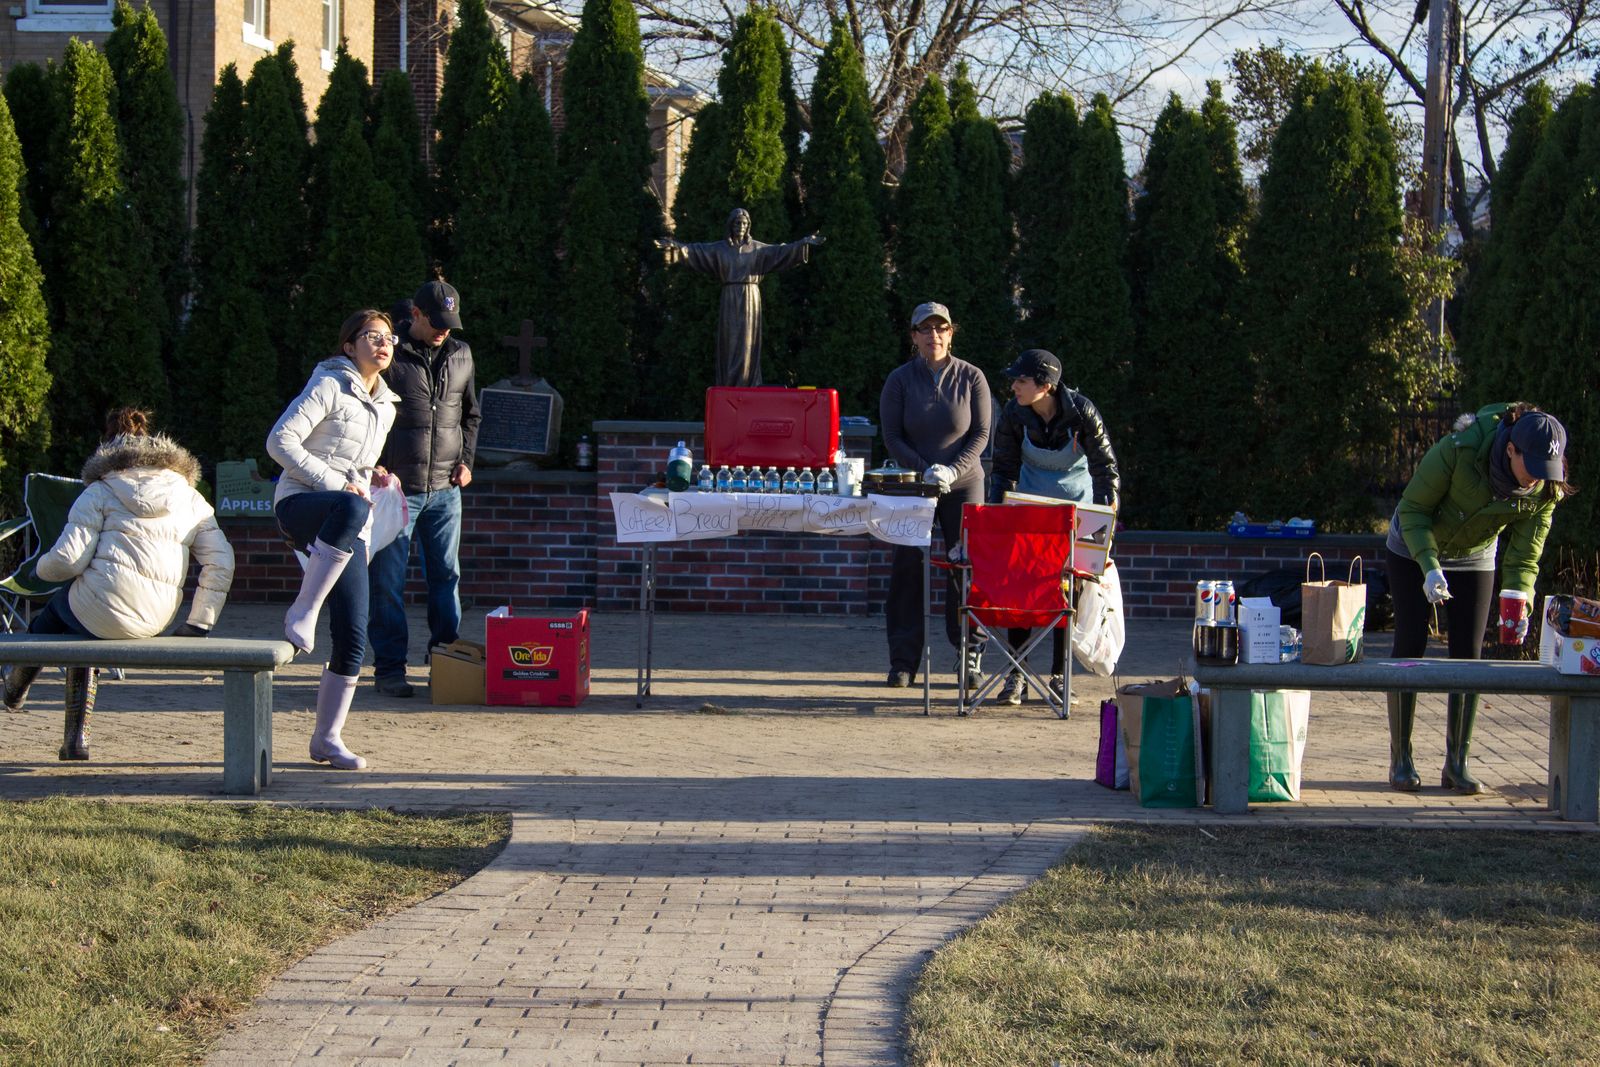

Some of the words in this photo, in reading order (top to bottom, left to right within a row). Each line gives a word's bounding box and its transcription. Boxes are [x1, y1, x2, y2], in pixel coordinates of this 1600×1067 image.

[1548, 439, 1560, 456] NY
[745, 494, 791, 512] HOT
[673, 498, 732, 536] Bread
[514, 650, 530, 661] Ore
